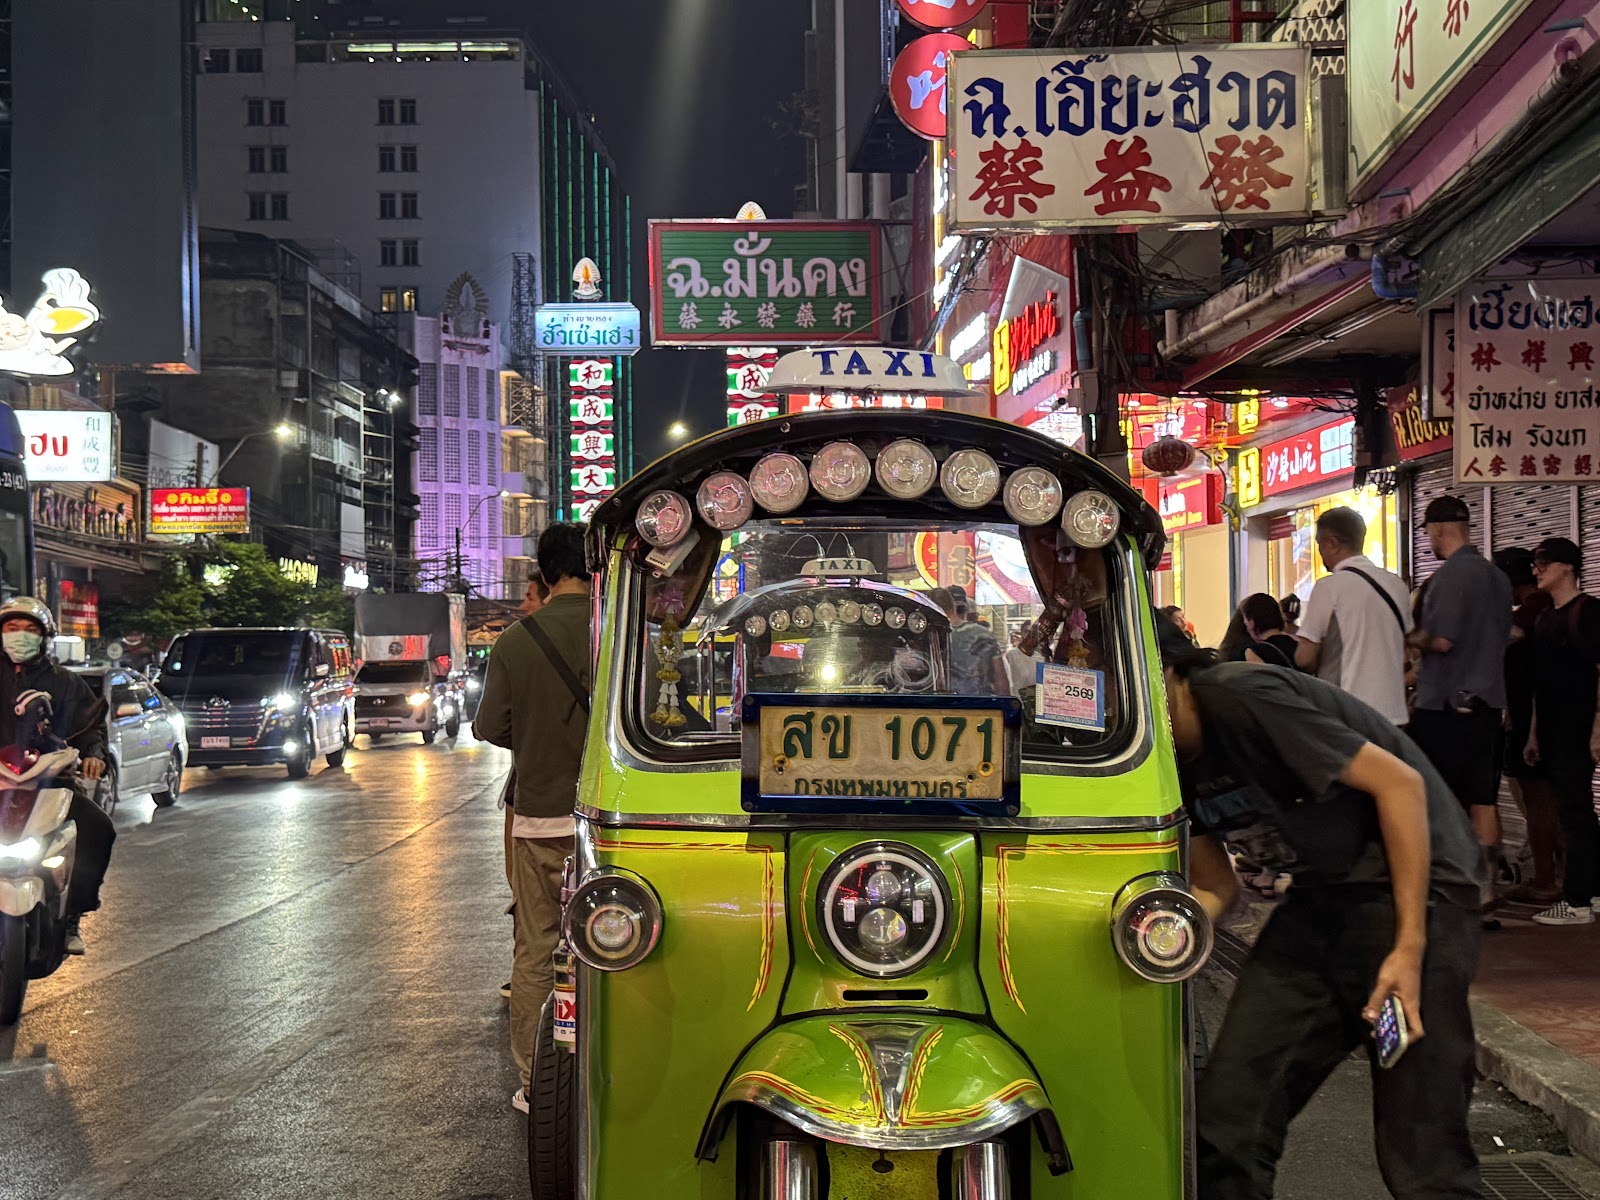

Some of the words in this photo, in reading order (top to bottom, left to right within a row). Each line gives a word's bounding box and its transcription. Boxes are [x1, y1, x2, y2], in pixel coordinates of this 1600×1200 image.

[968, 134, 1294, 218] 蔡益發
[666, 231, 866, 299] ฉ.มั่นคง
[678, 301, 857, 329] 蔡永發藥行
[812, 350, 937, 378] TAXI
[1470, 339, 1595, 373] 林祥興
[1468, 384, 1546, 411] จำหน่าย
[1470, 423, 1512, 448] โสม
[1526, 423, 1586, 448] รังนก
[817, 559, 864, 571] TAXI
[1064, 685, 1094, 701] 2569
[783, 710, 852, 759] สข
[884, 715, 993, 762] 1071
[794, 777, 968, 799] กรงเทพมหานคร
